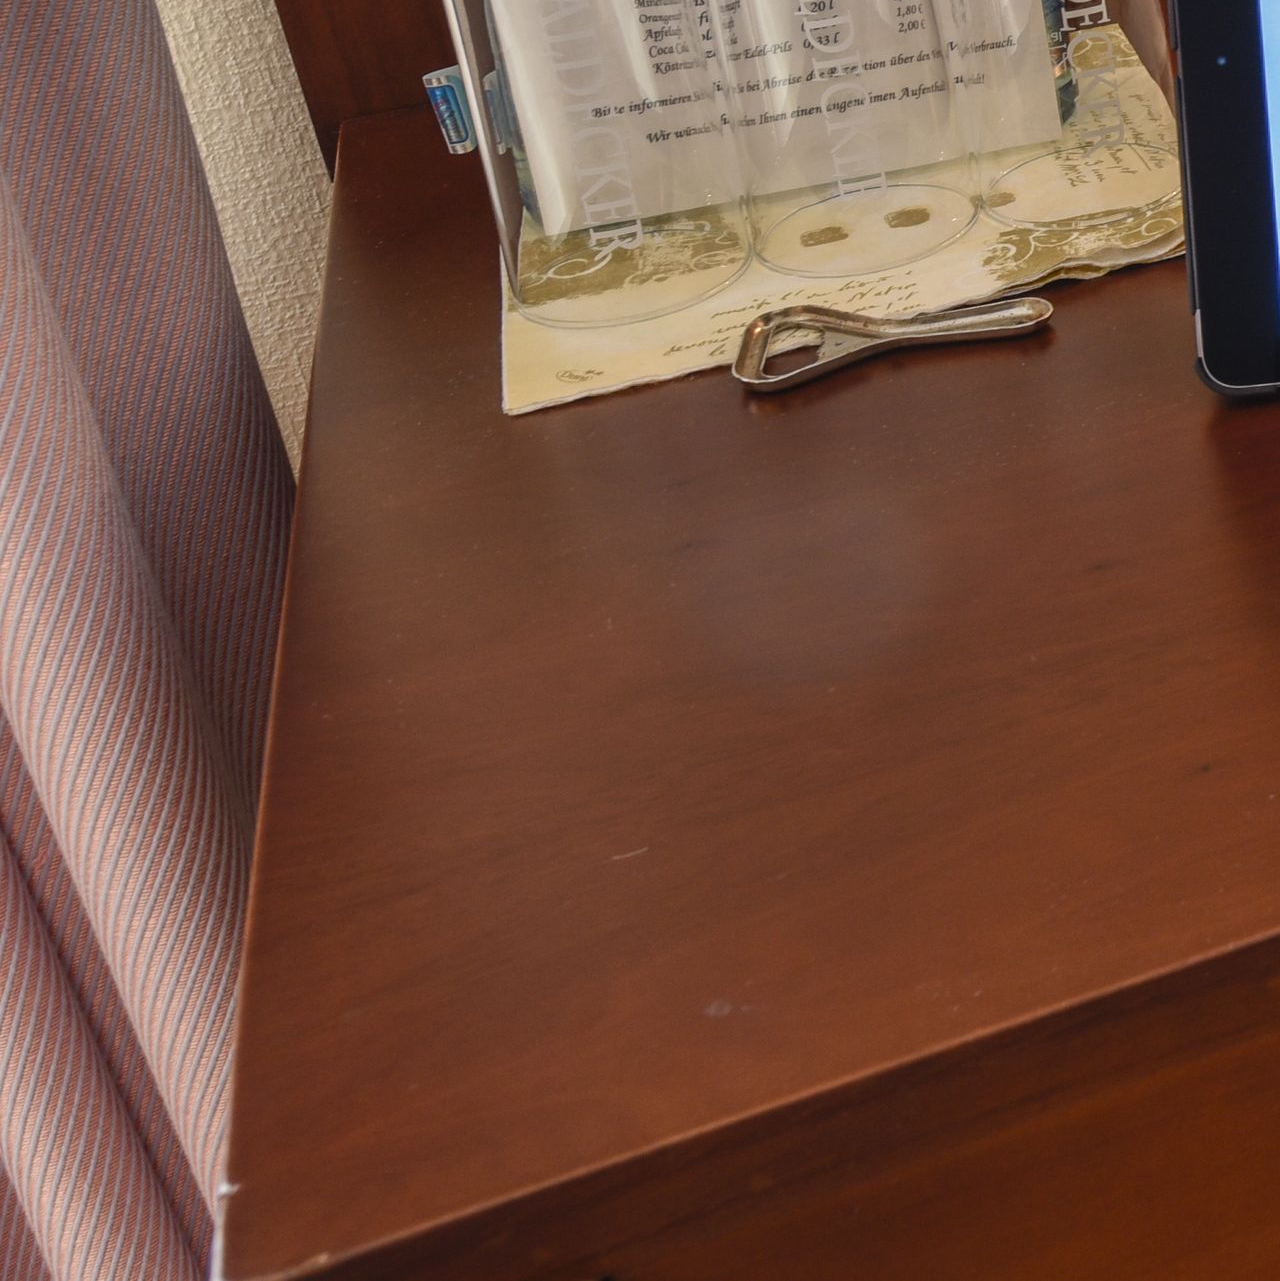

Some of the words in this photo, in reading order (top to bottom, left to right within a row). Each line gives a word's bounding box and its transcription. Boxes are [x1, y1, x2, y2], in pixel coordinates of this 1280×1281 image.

[648, 44, 675, 58] Coca
[896, 5, 918, 18] 1,80
[743, 40, 793, 60] Edel-Pils
[898, 21, 920, 34] 2,00
[629, 94, 692, 115] informieren
[762, 75, 802, 94] Abreise
[890, 52, 914, 66] über
[646, 126, 671, 144] Wir
[758, 111, 787, 126] Ihnen
[790, 103, 822, 119] einen
